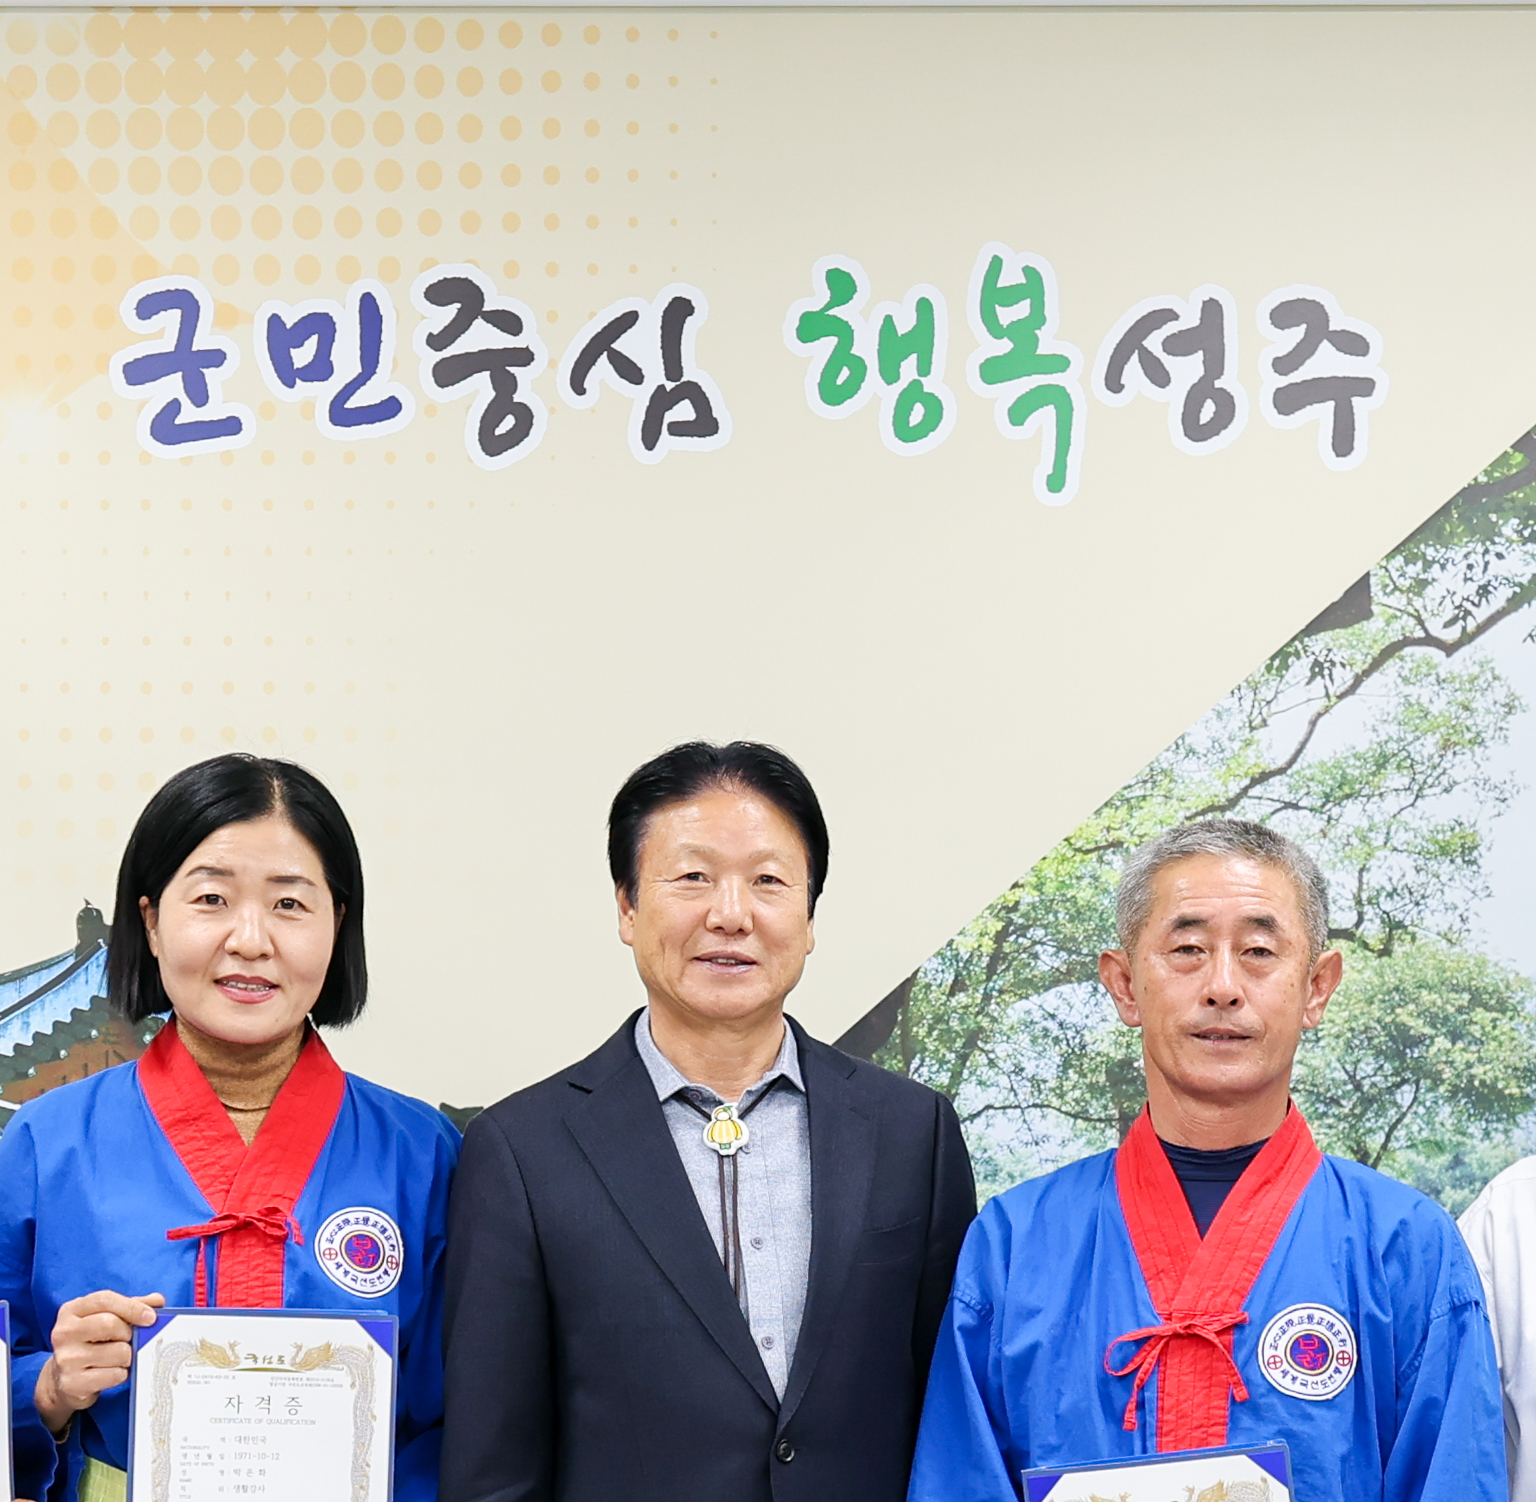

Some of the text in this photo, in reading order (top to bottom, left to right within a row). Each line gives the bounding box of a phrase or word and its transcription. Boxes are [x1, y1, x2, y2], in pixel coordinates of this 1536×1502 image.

[121, 254, 1376, 494] 군민중심 행복성주
[234, 1435, 267, 1445] 대한민국
[234, 1452, 280, 1460] 1971-10-12
